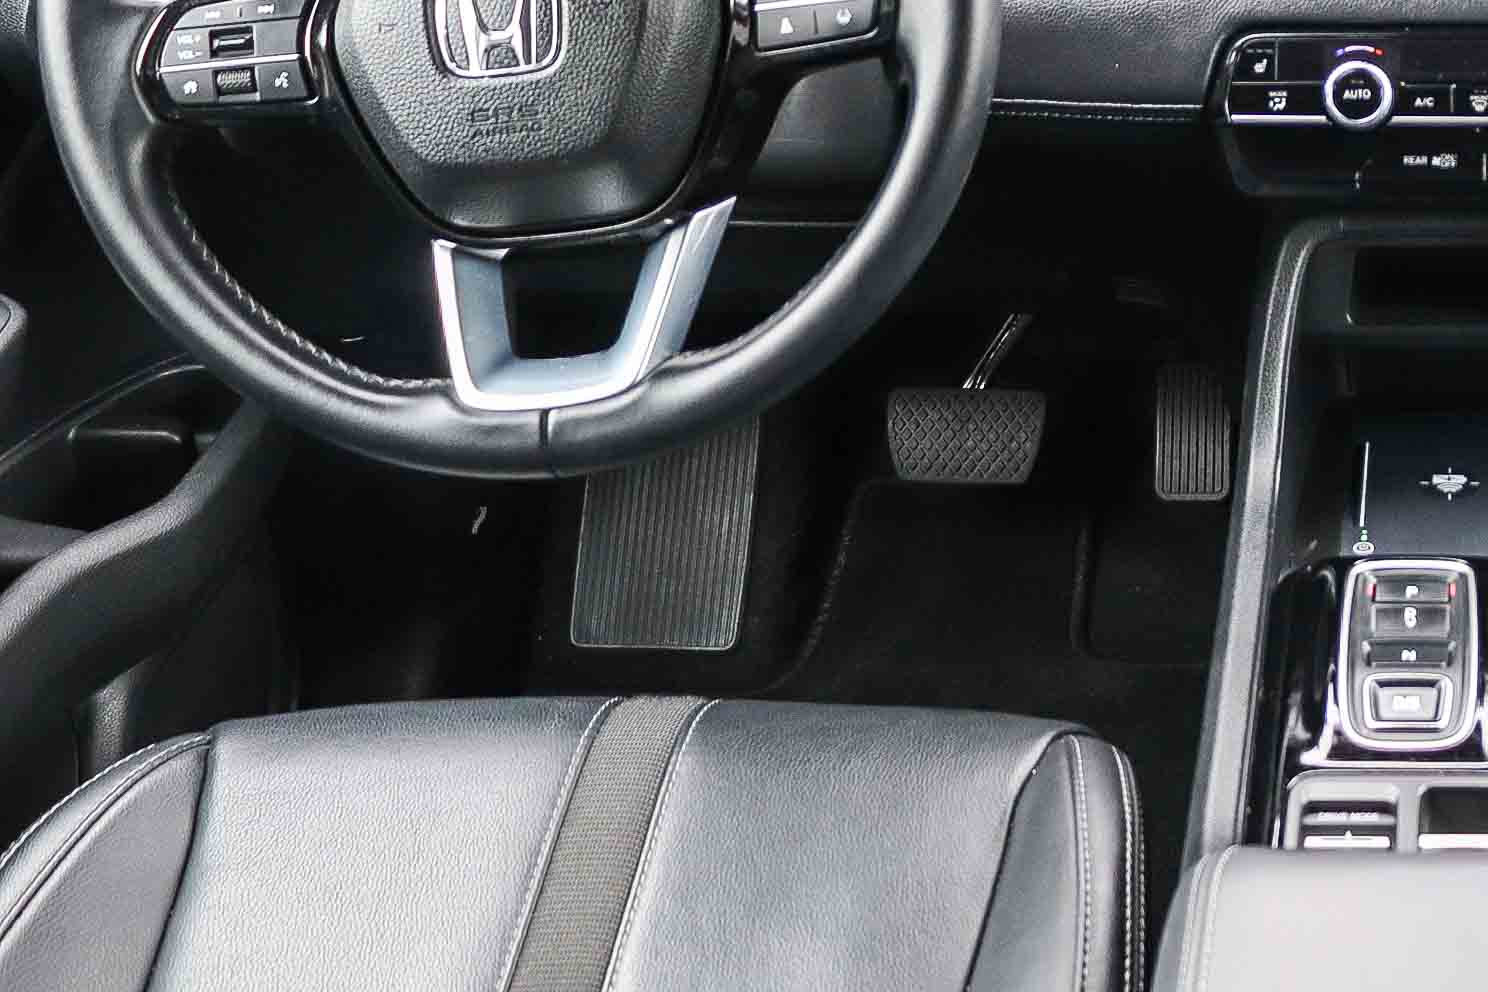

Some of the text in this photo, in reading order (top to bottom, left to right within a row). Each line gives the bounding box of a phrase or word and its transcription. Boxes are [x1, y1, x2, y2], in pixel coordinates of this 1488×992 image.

[1343, 88, 1371, 101] AUTO
[1414, 96, 1435, 108] A/C
[1403, 155, 1428, 166] REAR
